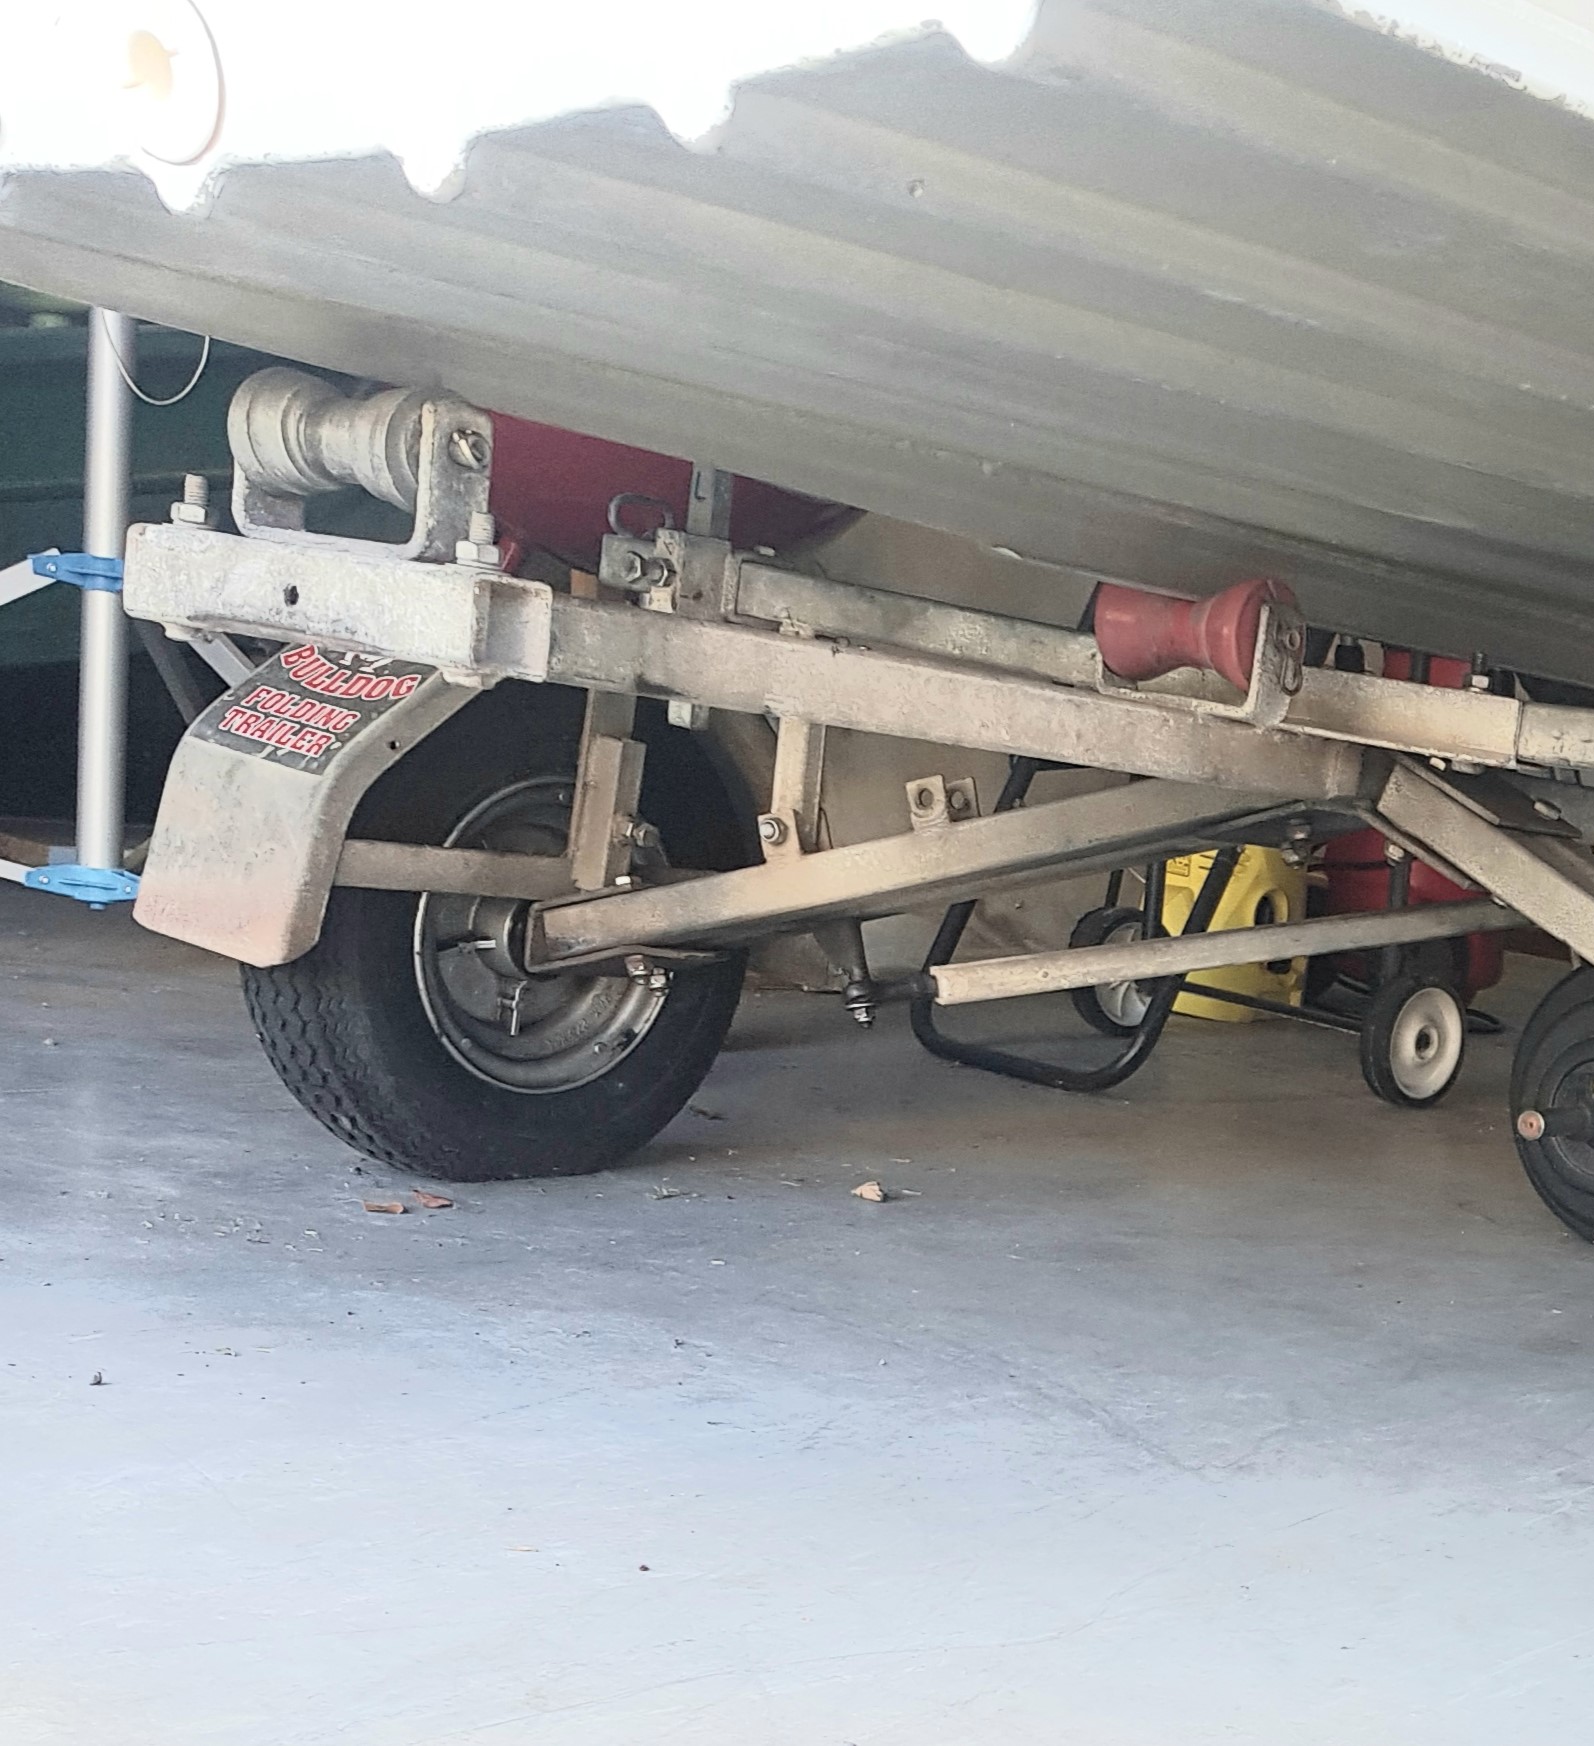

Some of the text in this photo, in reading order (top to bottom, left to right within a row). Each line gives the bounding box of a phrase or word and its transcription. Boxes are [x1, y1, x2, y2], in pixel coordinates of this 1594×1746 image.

[282, 644, 420, 699] BULLDOG
[220, 707, 334, 756] TRAILER
[242, 686, 360, 732] FOLDING
